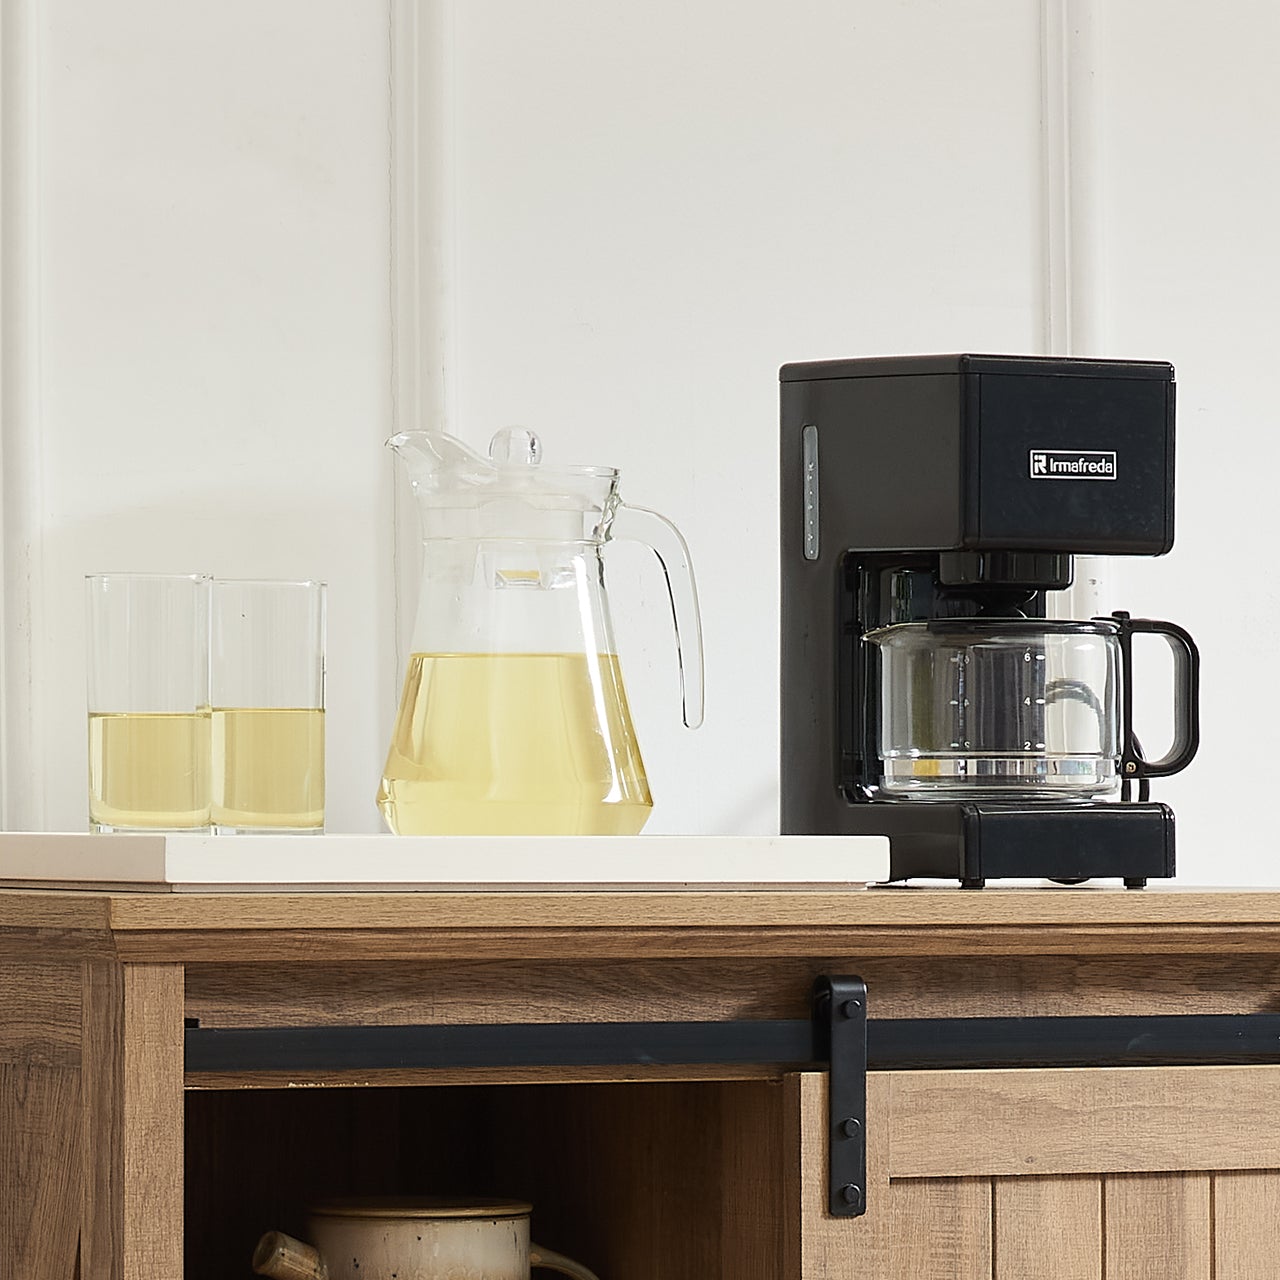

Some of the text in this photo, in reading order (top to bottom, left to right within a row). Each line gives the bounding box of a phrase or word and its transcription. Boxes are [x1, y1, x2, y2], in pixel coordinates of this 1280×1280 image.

[1024, 653, 1031, 661] 6
[1024, 697, 1031, 705] 4
[1024, 742, 1031, 750] 2
